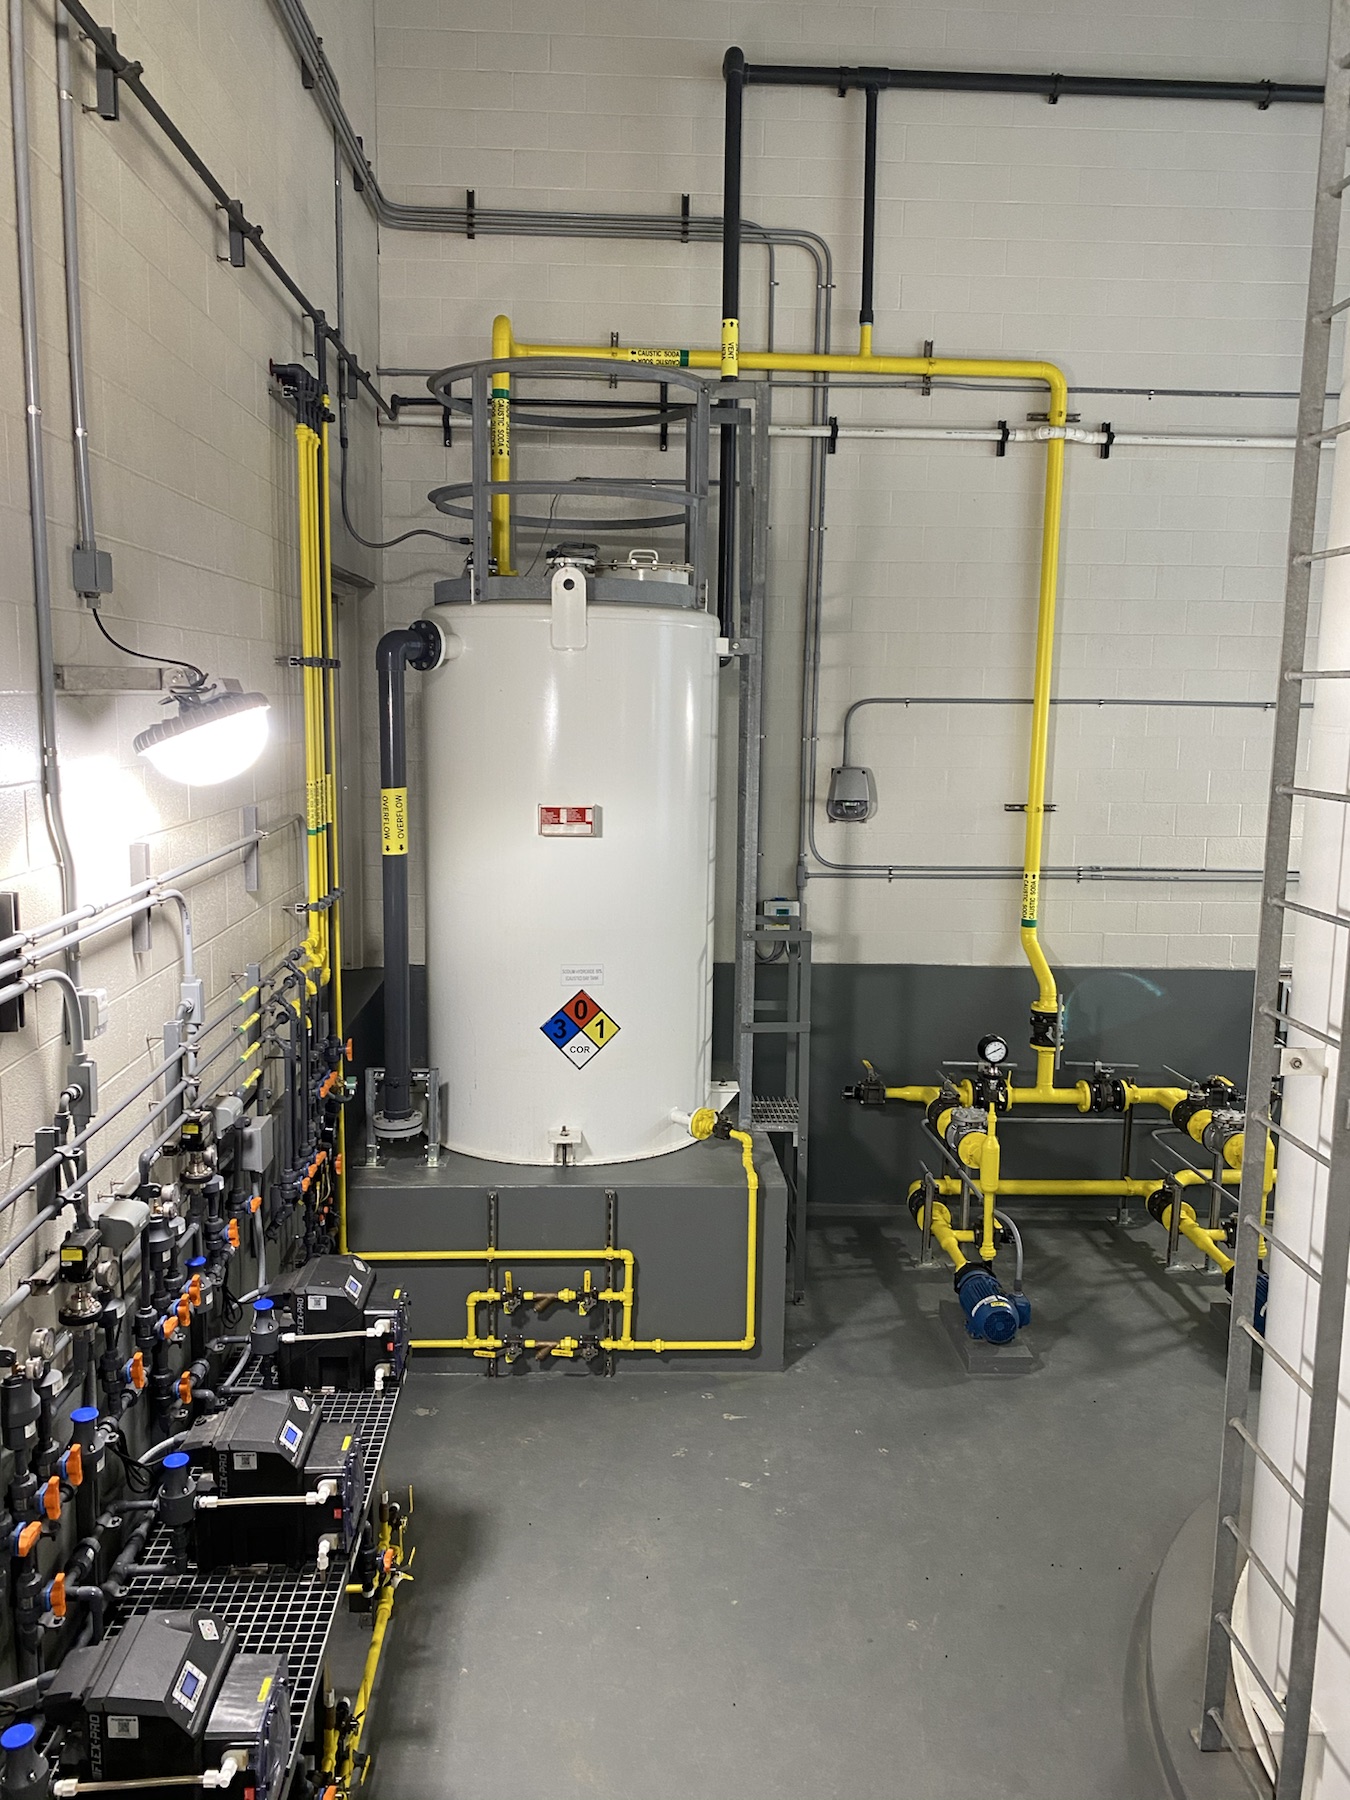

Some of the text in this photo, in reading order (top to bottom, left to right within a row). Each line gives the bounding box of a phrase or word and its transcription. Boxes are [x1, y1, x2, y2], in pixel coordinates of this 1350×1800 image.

[382, 795, 391, 840] OVERFLOW
[395, 794, 405, 839] OVERFLOW
[1029, 881, 1037, 896] SODA
[574, 999, 588, 1020] 0
[553, 1018, 604, 1039] 3 1
[569, 1045, 591, 1054] COR
[89, 1714, 102, 1774] FLEX-PRO
